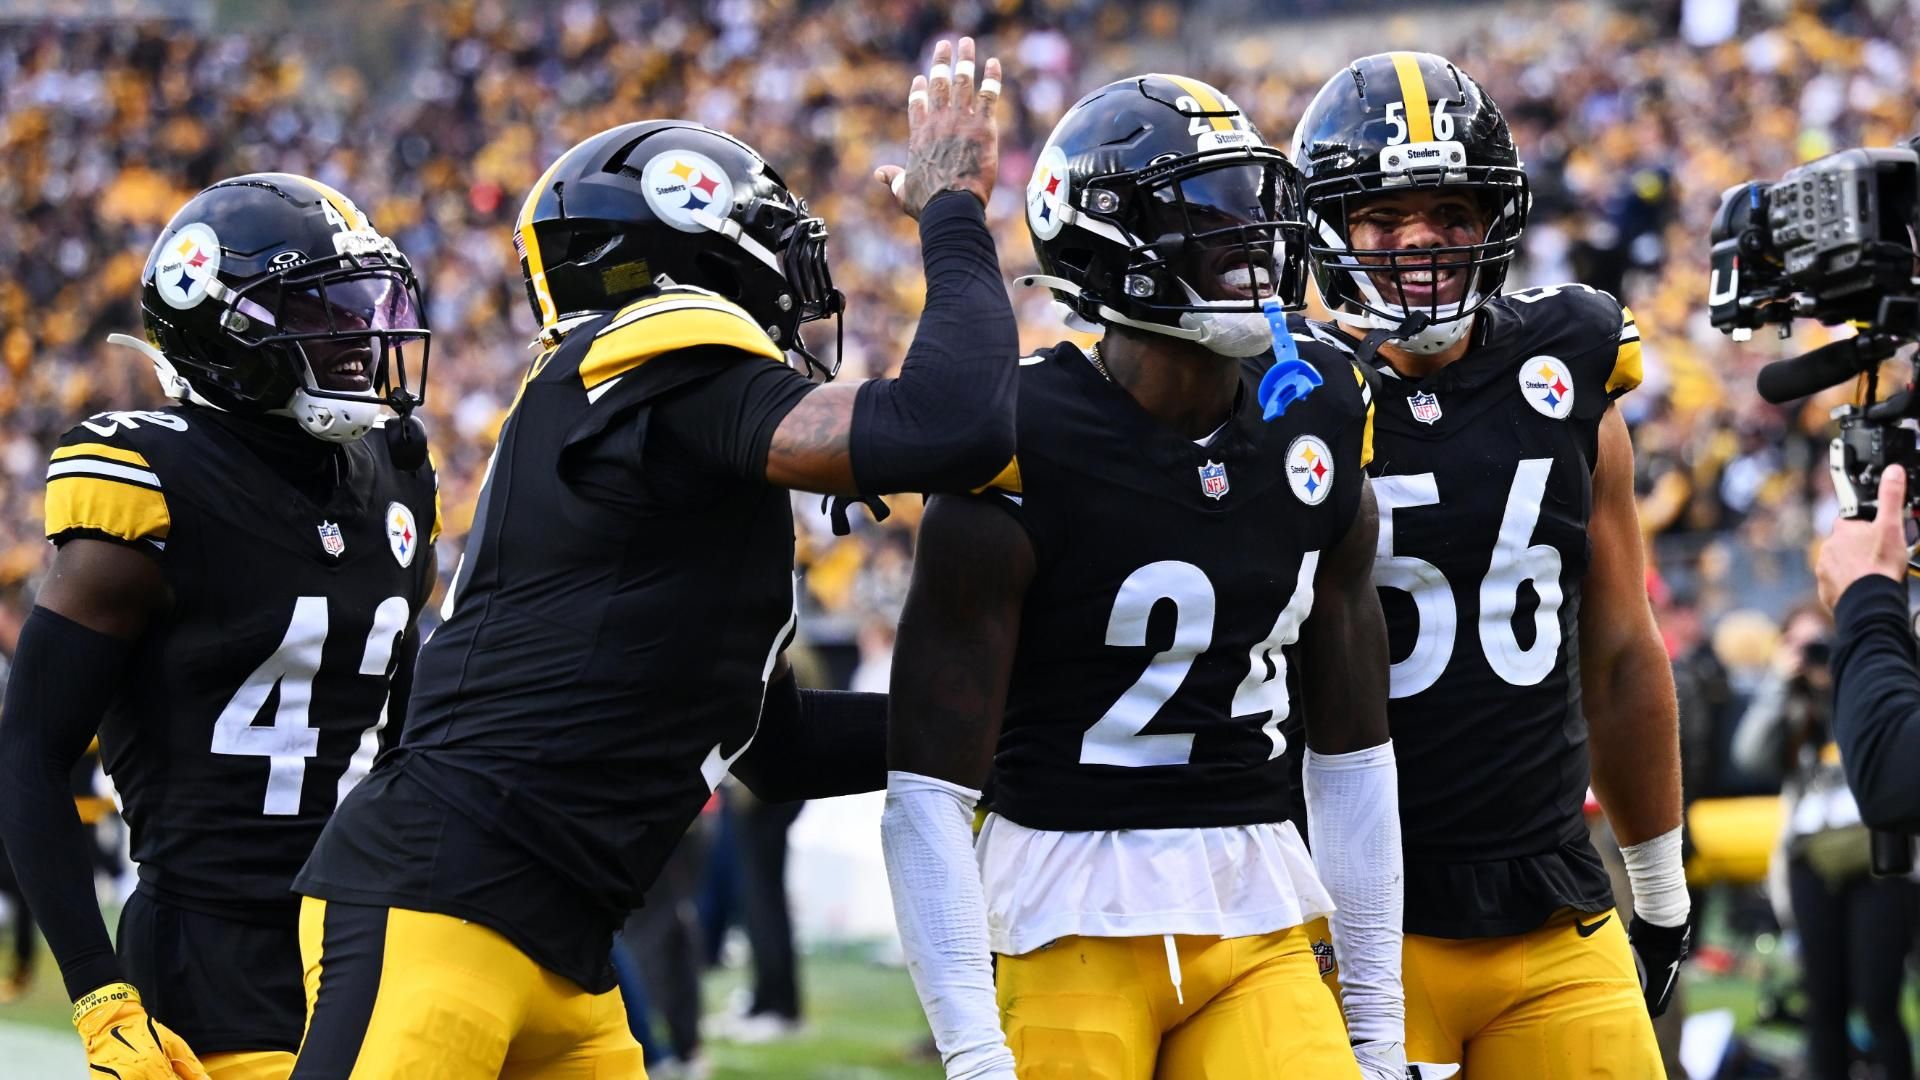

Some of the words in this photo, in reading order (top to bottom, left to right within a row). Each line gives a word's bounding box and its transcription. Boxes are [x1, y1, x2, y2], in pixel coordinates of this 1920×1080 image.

[1386, 98, 1454, 146] 56
[1407, 148, 1440, 159] Steelers
[656, 184, 686, 195] Steelers
[162, 262, 183, 274] Steelers
[268, 258, 308, 273] OAKLEY
[1525, 380, 1549, 390] Steelers
[1415, 405, 1438, 420] NFL
[1290, 465, 1310, 475] Steelers
[1205, 477, 1226, 493] NFL
[325, 536, 342, 550] NFL
[1372, 457, 1563, 699] 56
[1079, 550, 1320, 767] 24
